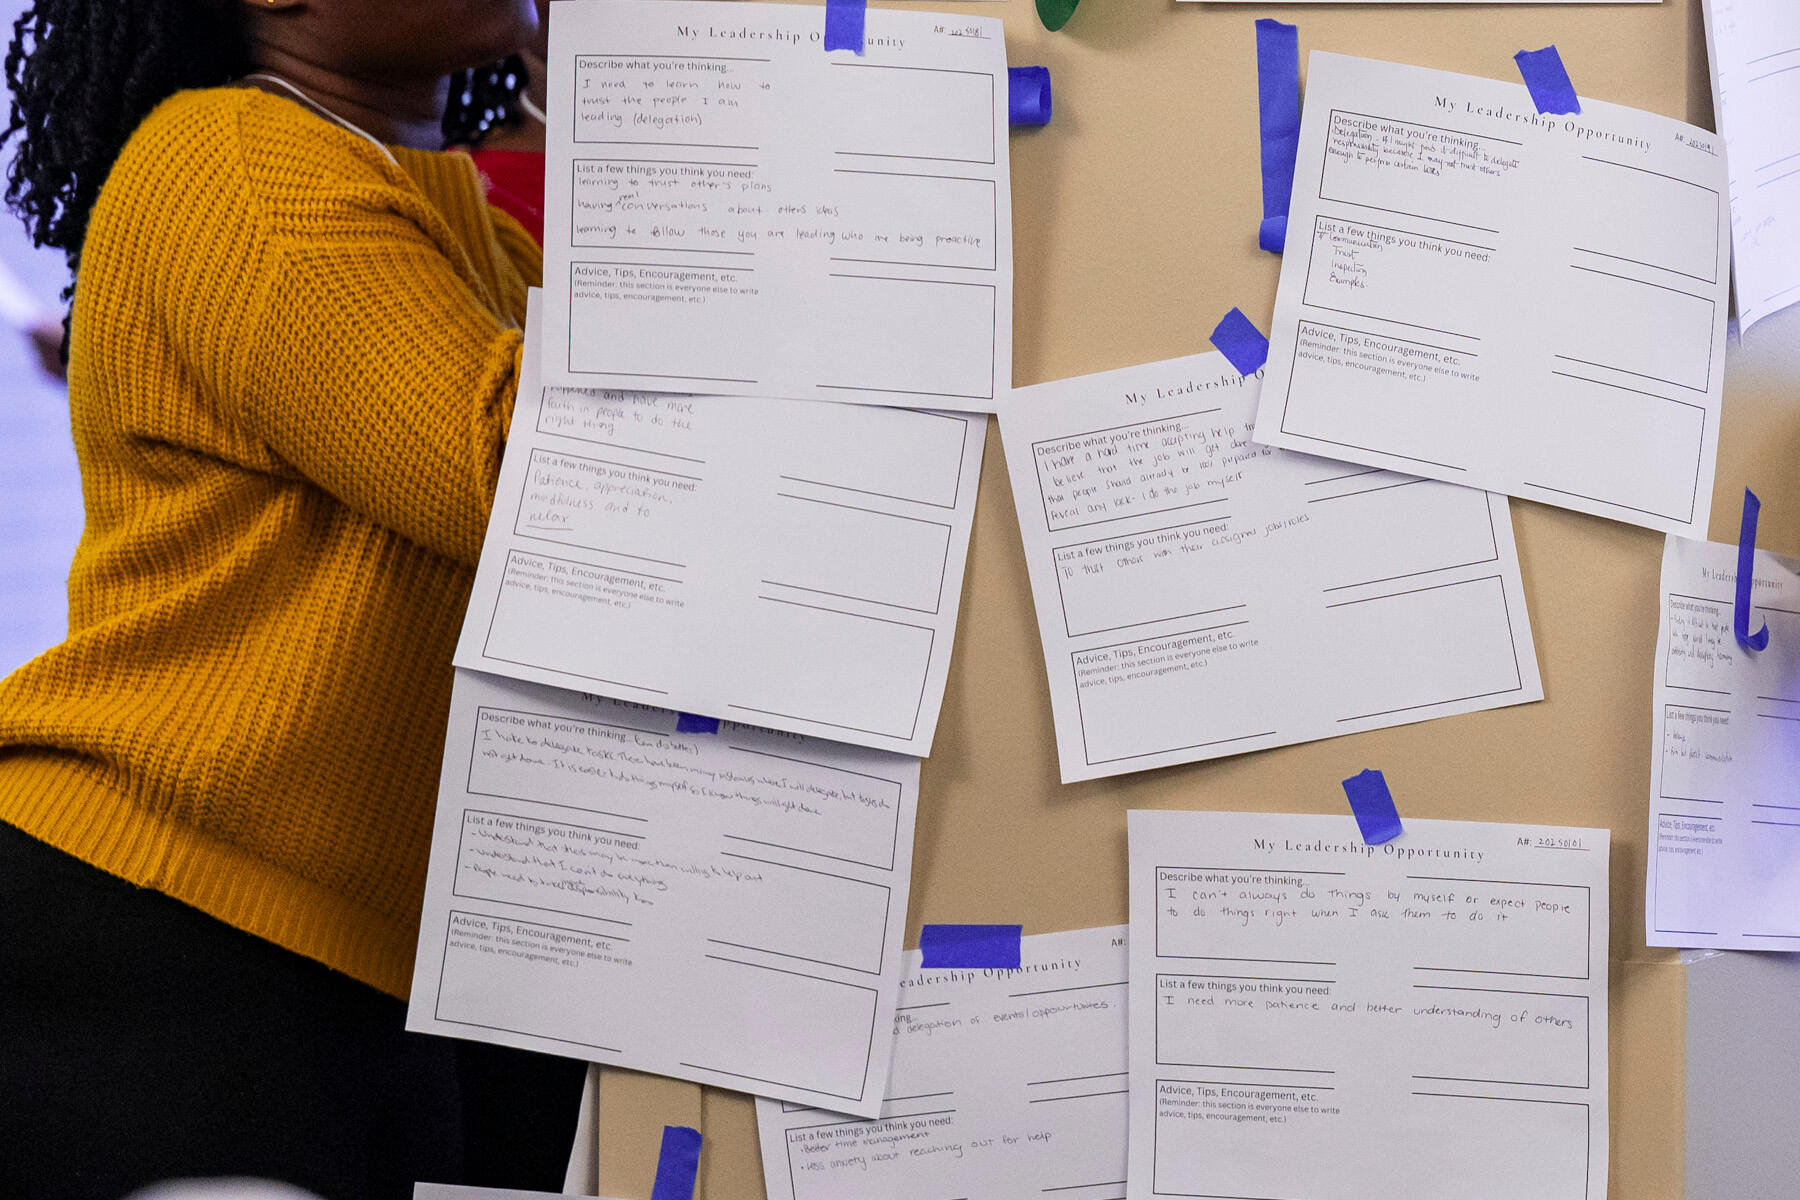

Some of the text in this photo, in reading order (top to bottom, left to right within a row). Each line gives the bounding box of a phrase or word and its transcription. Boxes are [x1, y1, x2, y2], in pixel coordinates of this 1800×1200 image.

[677, 25, 801, 45] My Leadership
[579, 59, 625, 71] Describe
[625, 59, 652, 71] what
[652, 60, 686, 73] you're
[1434, 95, 1651, 154] My Leadership Opportunity
[1299, 338, 1480, 382] (Reminder: this section is everyone else to write
[1124, 374, 1247, 406] My Leadership
[510, 554, 664, 592] Advice, Tips, Encouragement, etc.
[481, 711, 526, 726] Describe
[527, 718, 552, 730] what
[553, 722, 585, 735] you're
[1253, 838, 1484, 864] My Leadership Opportunity
[1163, 887, 1177, 899] I
[1192, 889, 1228, 901] can't
[1239, 890, 1288, 904] always
[1300, 887, 1316, 899] do
[1387, 889, 1401, 903] by
[1413, 892, 1455, 904] myself
[1465, 895, 1479, 904] or
[1489, 897, 1526, 910] expect
[1535, 899, 1571, 915] people
[1166, 906, 1179, 918] to
[1193, 905, 1206, 917] do
[1219, 906, 1255, 926] things
[1264, 908, 1297, 927] right
[1311, 908, 1339, 918] when
[1347, 905, 1362, 918] I
[1400, 907, 1431, 919] them
[1440, 910, 1457, 921] to
[1468, 909, 1484, 922] do
[1497, 911, 1509, 922] it
[900, 958, 1082, 988] eadership Opportunity
[1164, 995, 1573, 1030] I need more patience and better understanding of others
